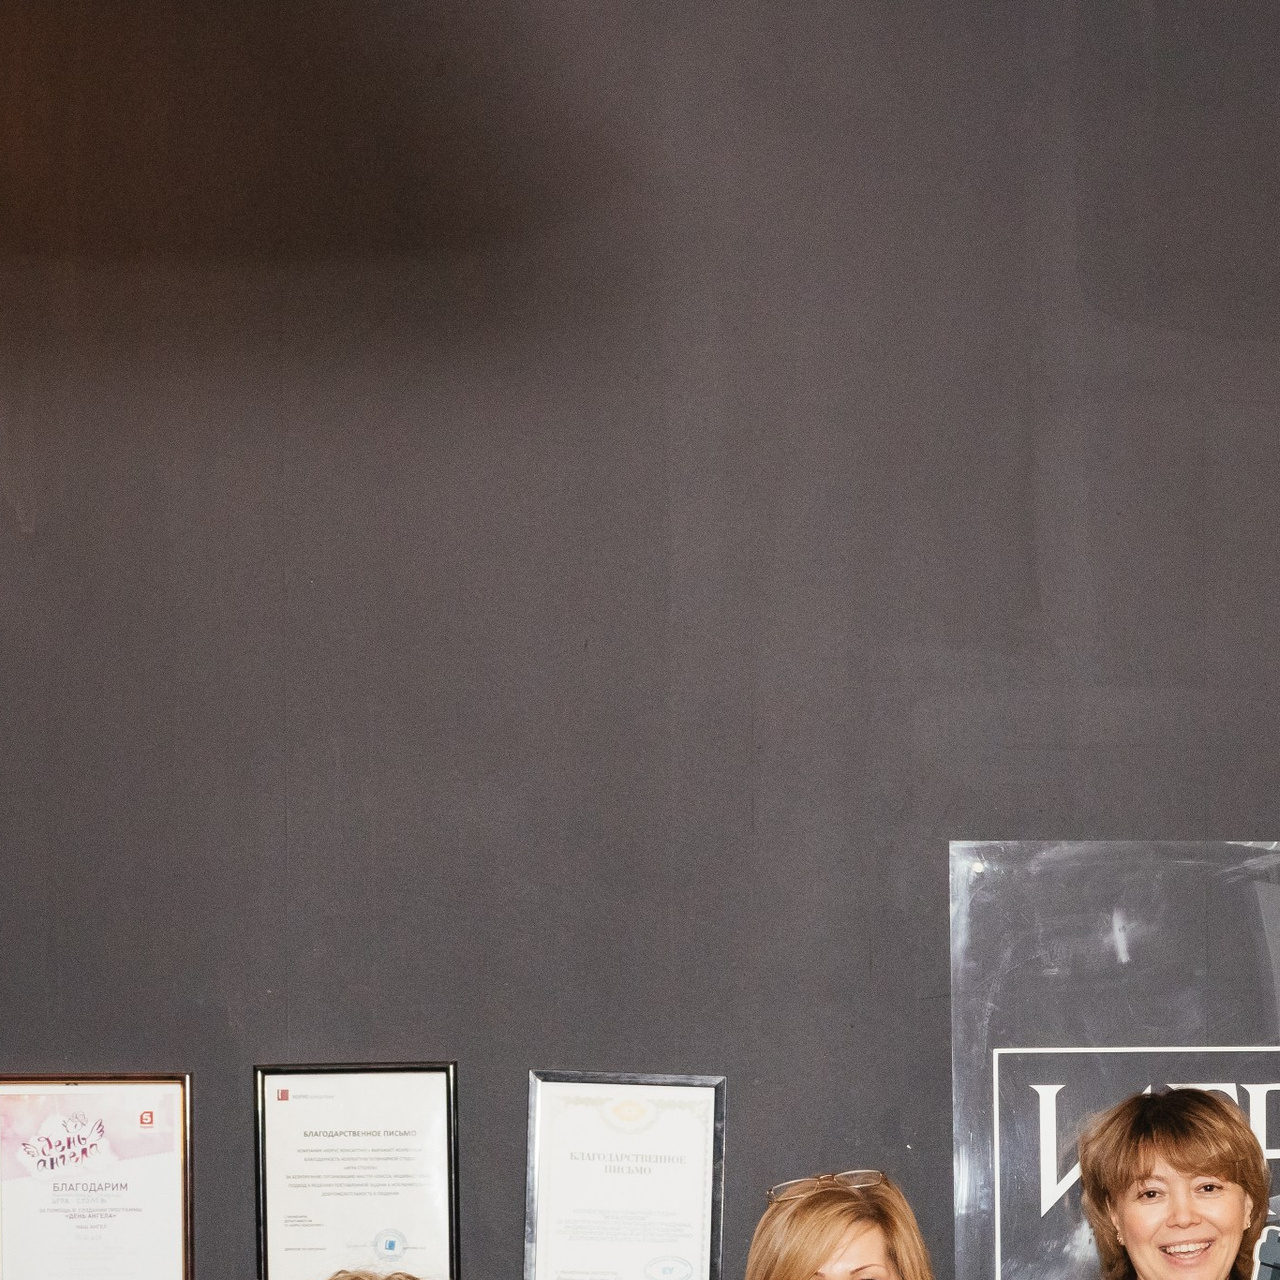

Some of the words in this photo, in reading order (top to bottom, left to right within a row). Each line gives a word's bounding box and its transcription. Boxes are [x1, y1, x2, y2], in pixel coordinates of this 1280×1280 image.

[303, 1130, 382, 1138] БЛАГОДАРСТВЕННОЕ
[383, 1130, 417, 1138] ПИСЬМО
[570, 1151, 687, 1165] БЛАГОДАРСТВЕННОЕ
[604, 1165, 652, 1175] ПИСЬМО
[52, 1182, 128, 1193] БЛАГОДАРИМ
